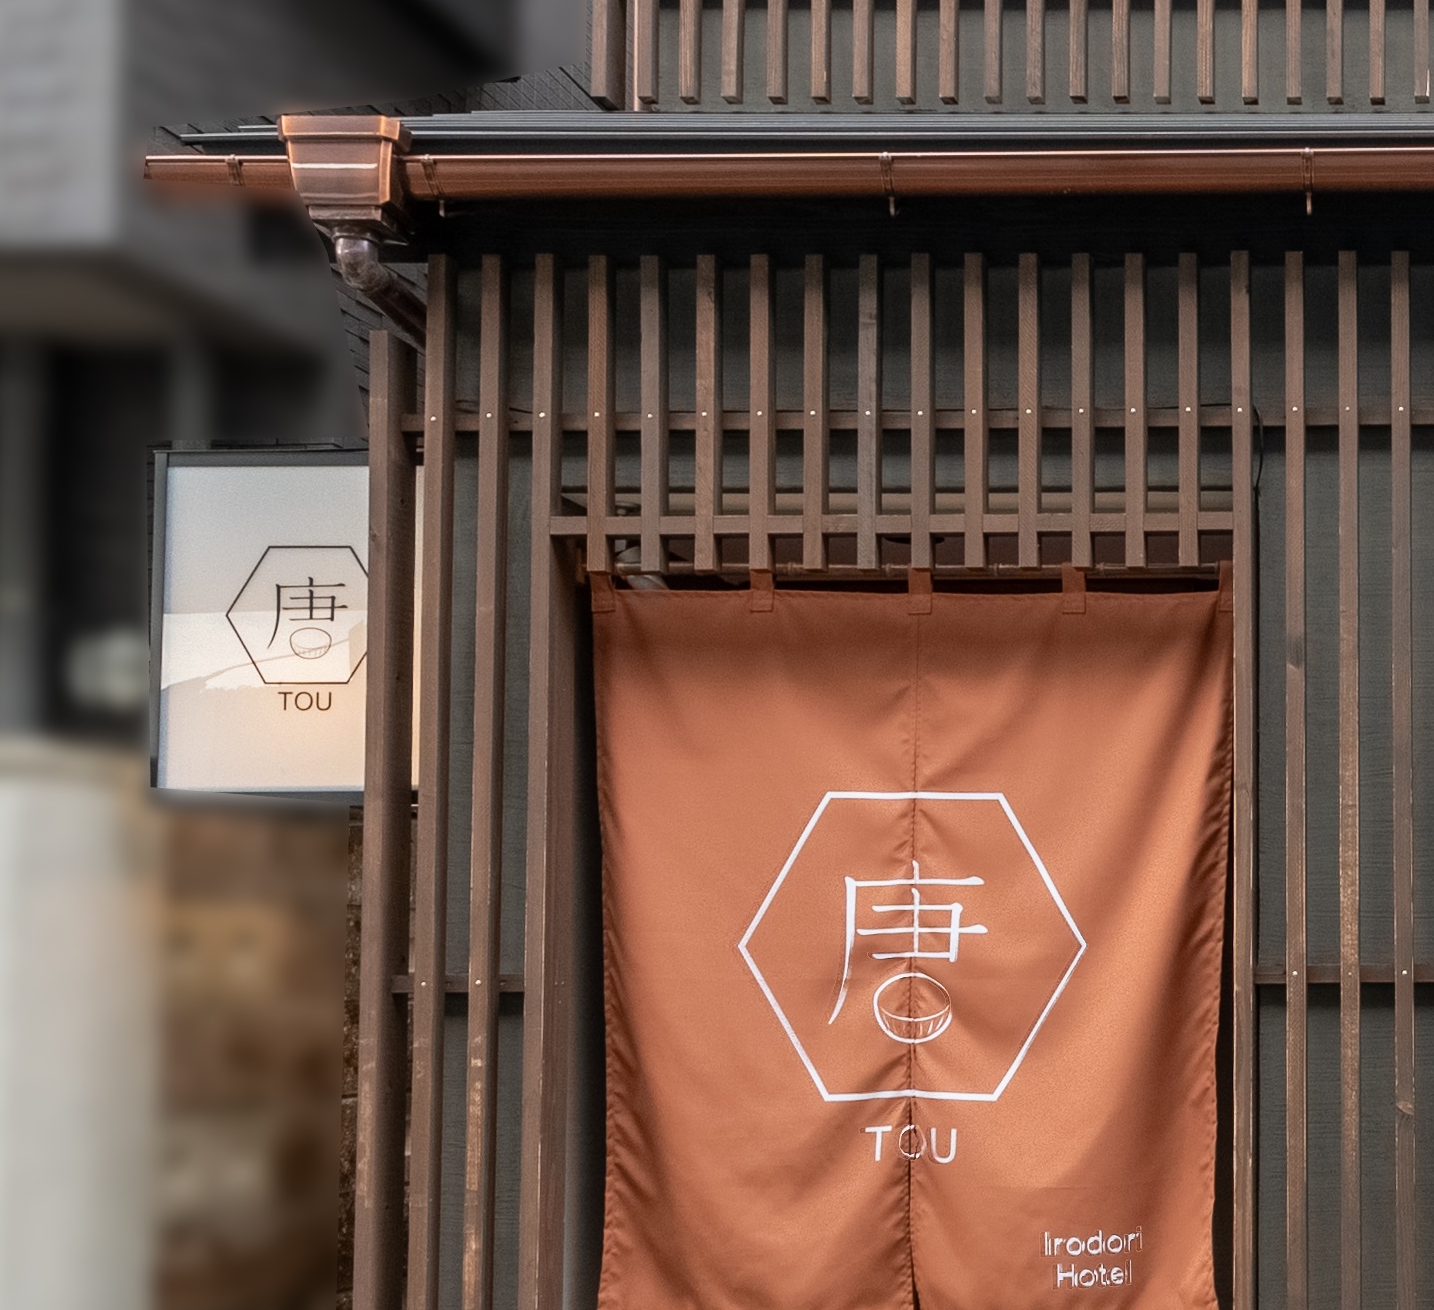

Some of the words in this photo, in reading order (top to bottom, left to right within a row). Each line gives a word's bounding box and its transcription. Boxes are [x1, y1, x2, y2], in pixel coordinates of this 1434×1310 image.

[267, 577, 348, 659] 唐
[277, 691, 332, 712] TOU
[827, 860, 989, 1044] 唐
[863, 1124, 957, 1164] TOU
[1041, 1226, 1143, 1257] Irodori
[1054, 1260, 1132, 1289] Hotel
